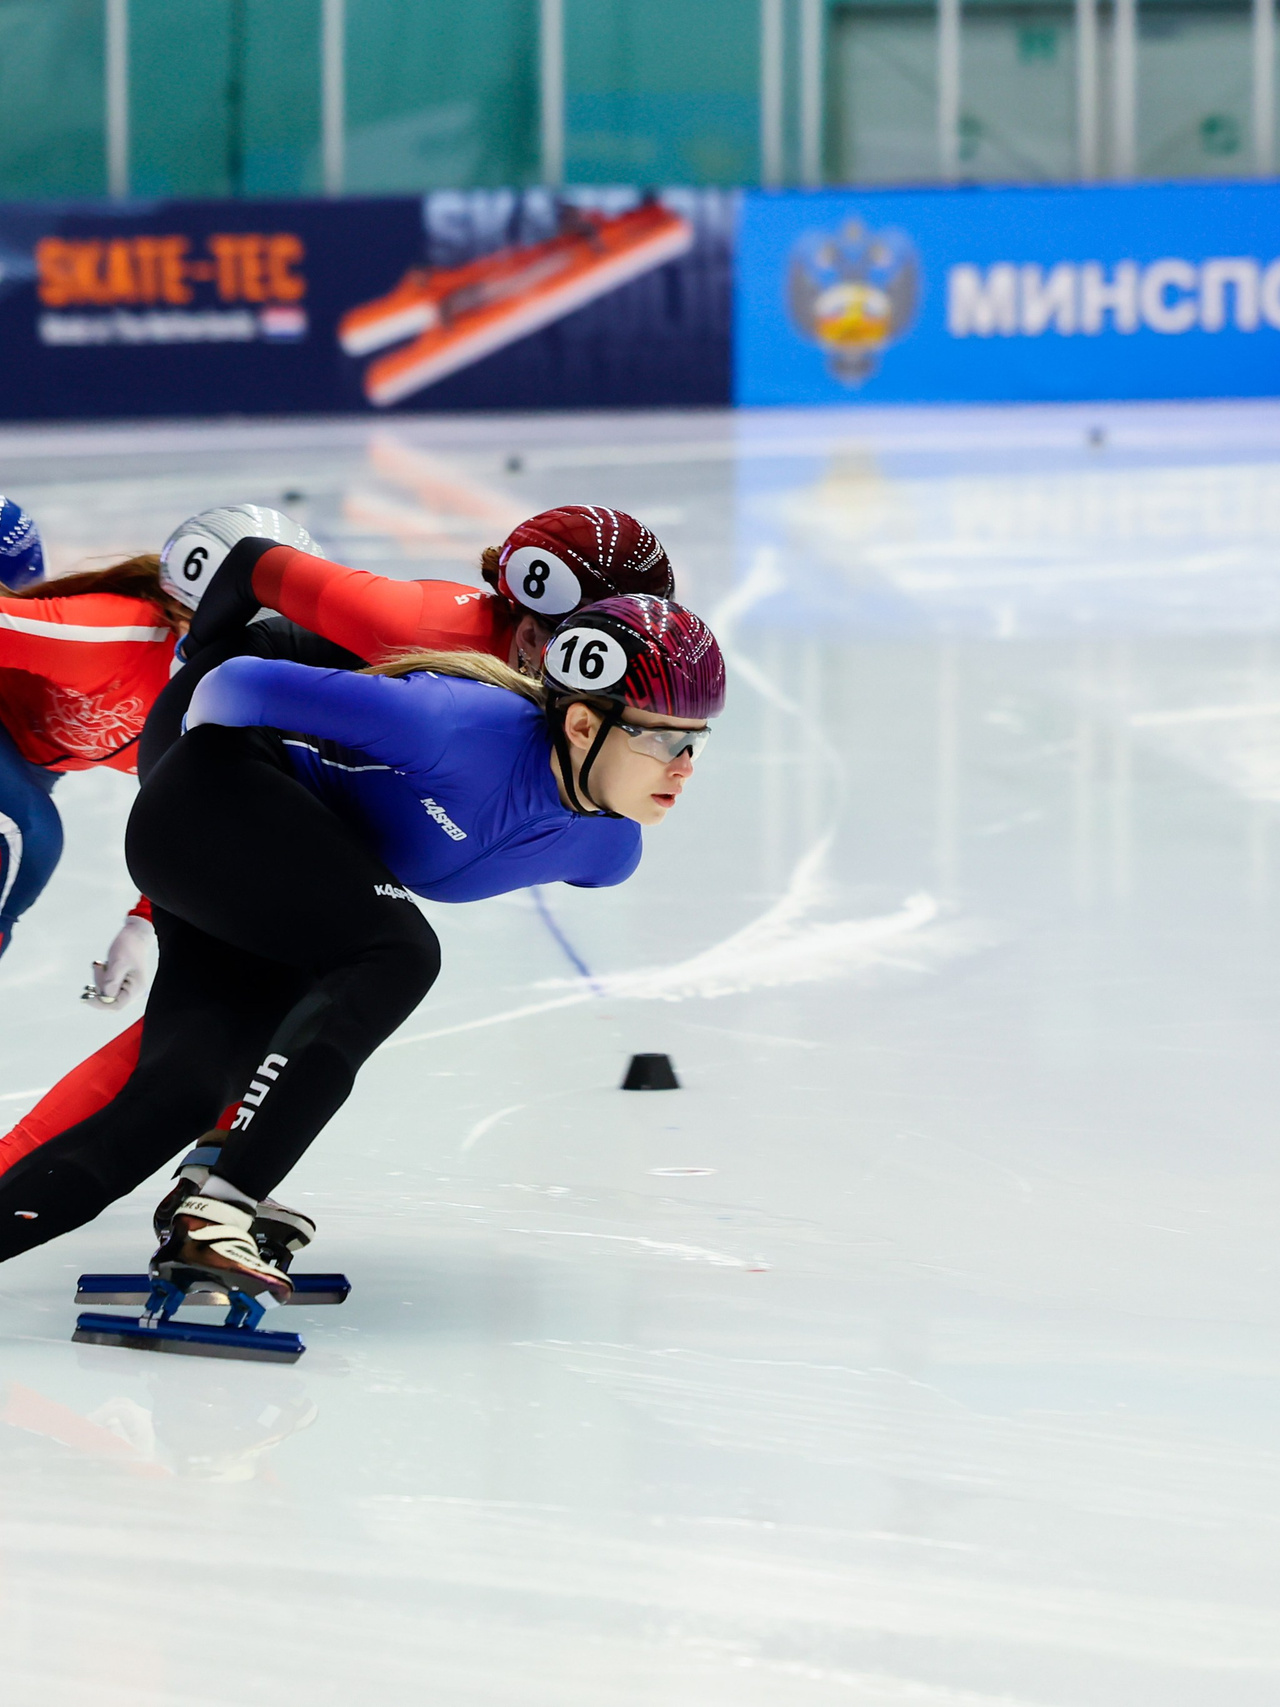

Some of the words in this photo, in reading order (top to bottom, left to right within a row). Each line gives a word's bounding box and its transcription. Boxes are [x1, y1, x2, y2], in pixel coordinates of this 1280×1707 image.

[36, 235, 305, 306] SKATE-TEC
[183, 546, 209, 581] 6
[523, 559, 550, 599] 8
[560, 635, 608, 679] 16
[420, 798, 467, 841] K4SPEED
